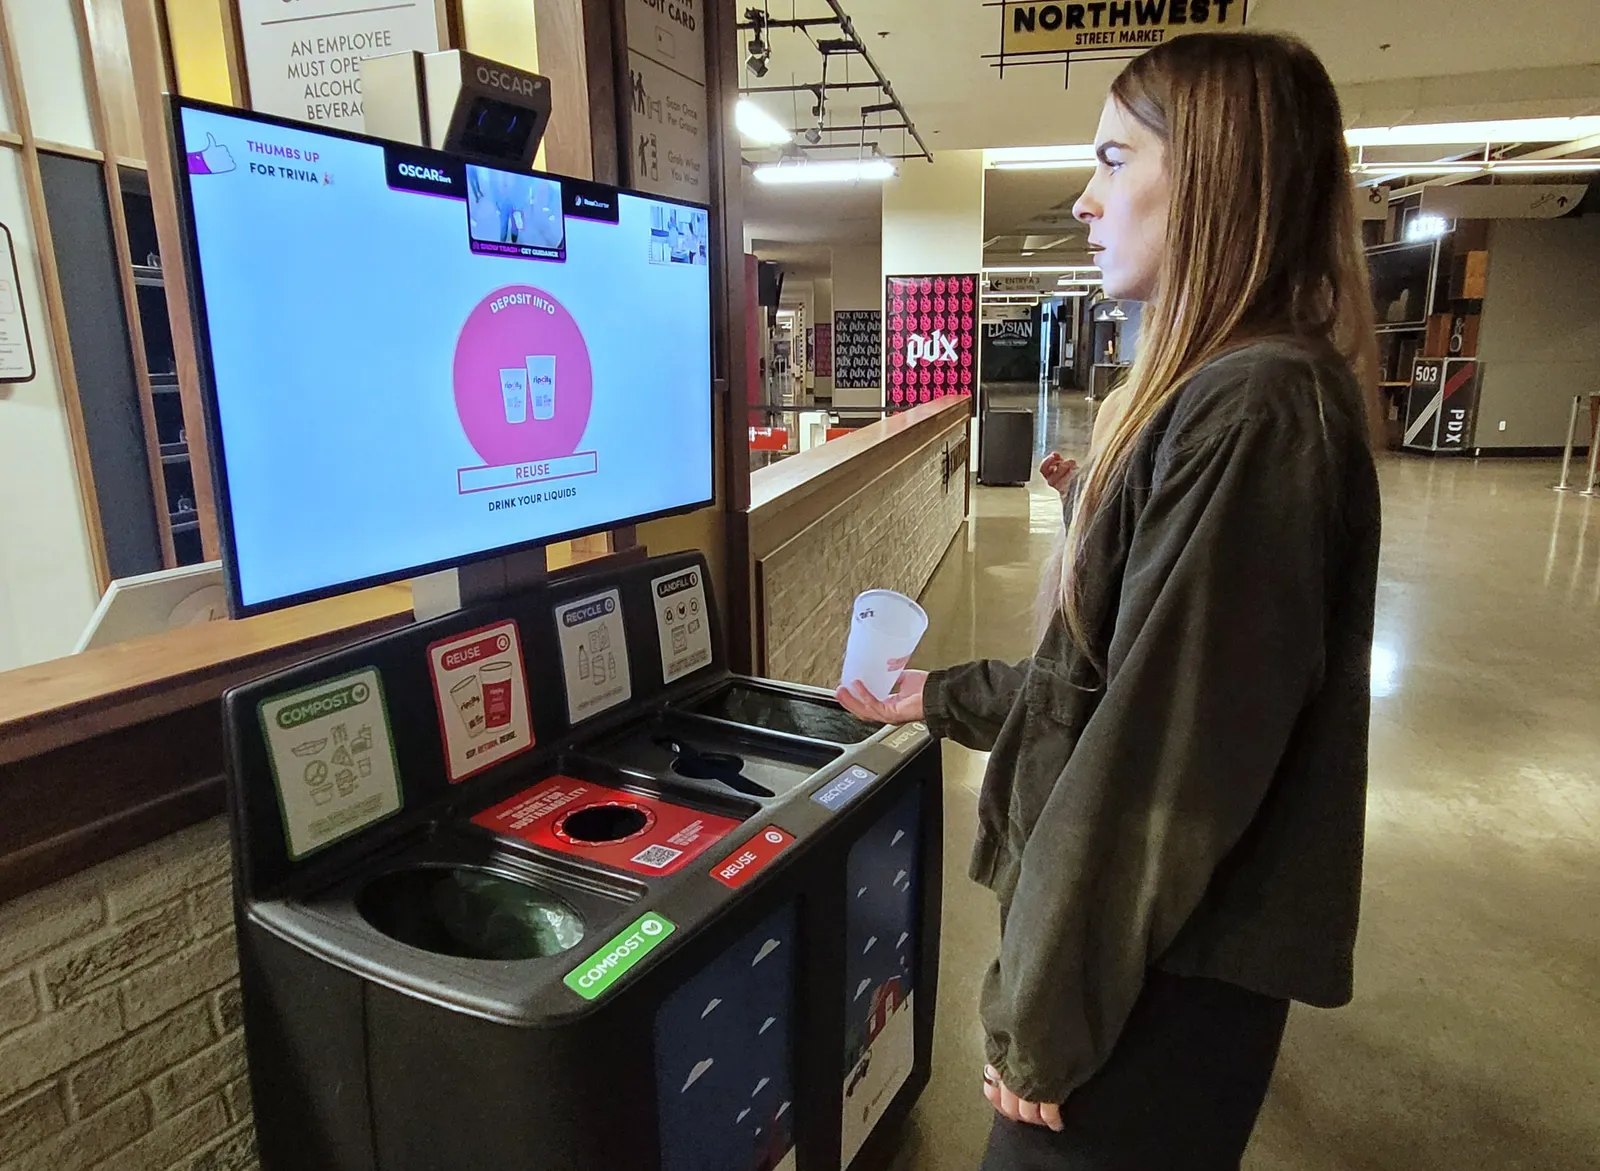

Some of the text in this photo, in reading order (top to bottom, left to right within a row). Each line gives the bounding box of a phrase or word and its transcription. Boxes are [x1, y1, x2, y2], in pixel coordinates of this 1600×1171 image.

[668, 3, 696, 32] CARD
[1014, 0, 1234, 32] NORTHWEST
[291, 30, 392, 57] AN EMPLOYEE
[1075, 29, 1165, 46] STREET MARKET
[287, 56, 365, 79] MUST OPE
[477, 66, 533, 97] OSCAR
[246, 139, 320, 163] THUMBS UP
[249, 162, 319, 184] FOR TRIVIA
[398, 163, 439, 182] OSCAR
[489, 293, 555, 315] DEPOSIT INTO
[988, 321, 1033, 338] ELYSIAN
[906, 329, 959, 368] pdx
[1415, 366, 1438, 382] 503
[1445, 409, 1466, 443] PDX
[515, 463, 550, 479] REUSE
[488, 487, 577, 511] DRINK YOUR LIQUIDS
[659, 578, 689, 594] LANDFILL
[565, 603, 602, 624] RECYCLE
[446, 646, 481, 666] REUSE
[280, 691, 350, 725] COMPOST
[819, 777, 856, 804] RECYCLE
[720, 850, 758, 880] REUSE
[578, 931, 645, 988] COMPOST
